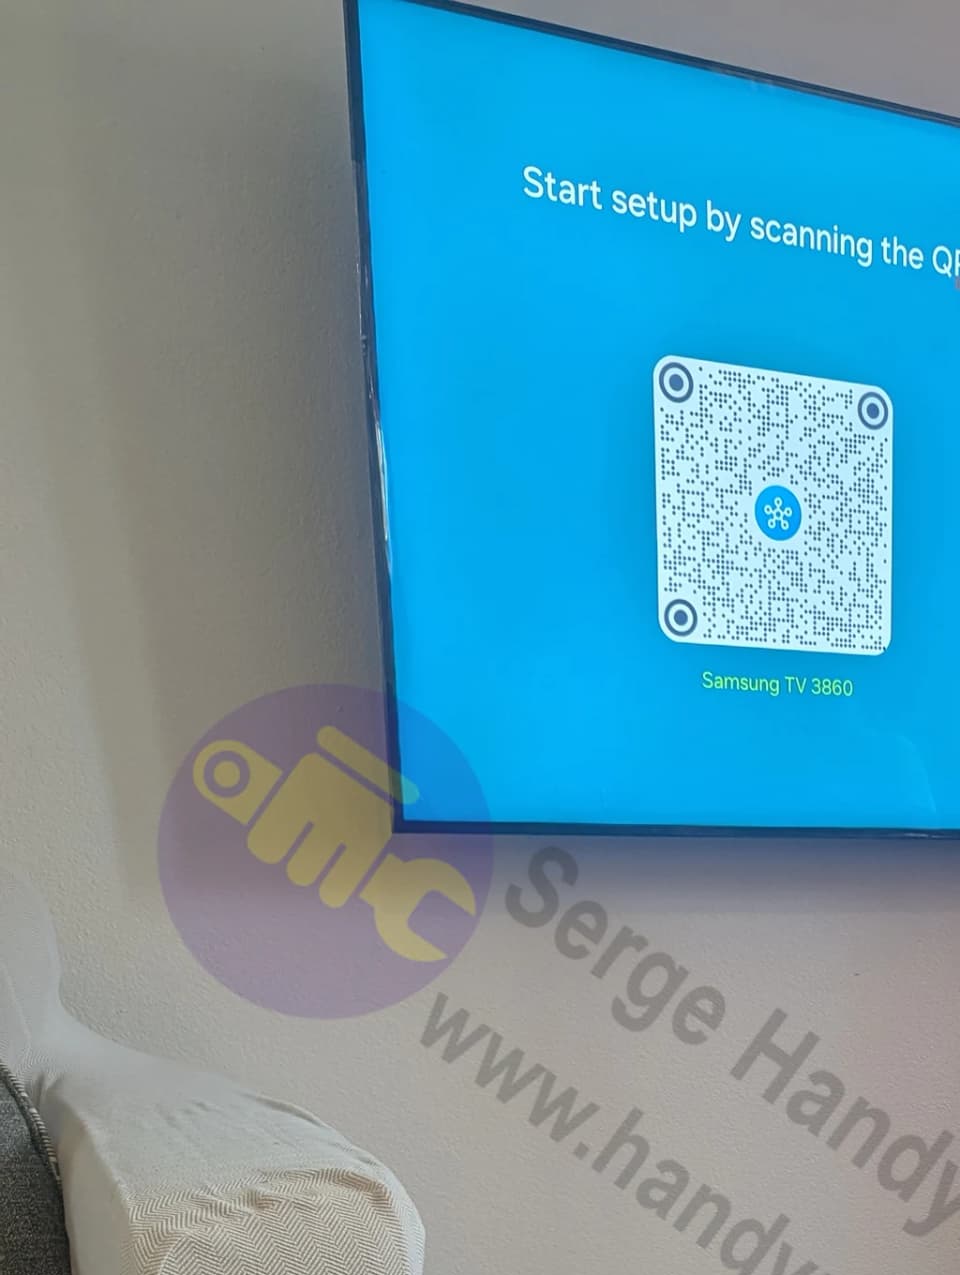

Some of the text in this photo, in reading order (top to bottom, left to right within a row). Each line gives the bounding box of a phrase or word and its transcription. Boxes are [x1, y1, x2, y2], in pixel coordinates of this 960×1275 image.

[523, 165, 602, 209] Start
[612, 188, 697, 232] setup
[706, 199, 740, 241] by
[750, 214, 873, 267] scanning
[881, 236, 924, 269] the
[702, 671, 854, 697] Samsung TV 3860
